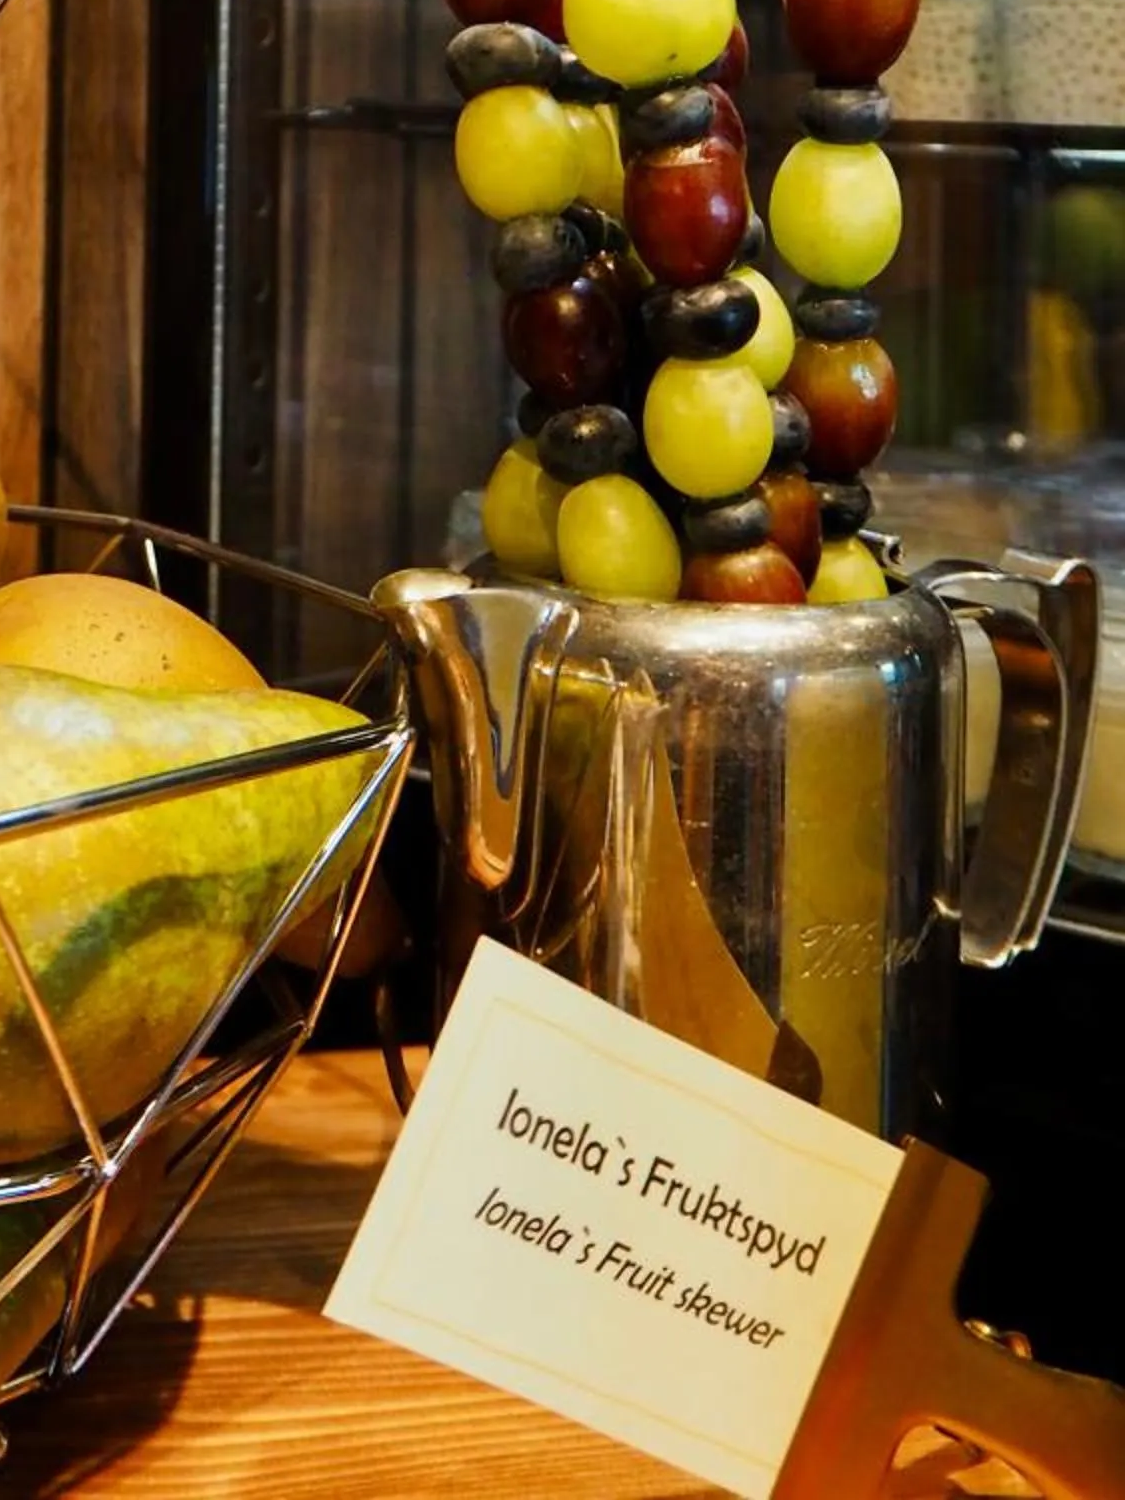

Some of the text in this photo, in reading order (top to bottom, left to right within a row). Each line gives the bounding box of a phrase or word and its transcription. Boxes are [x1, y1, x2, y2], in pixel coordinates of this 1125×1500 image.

[639, 1154, 828, 1277] Fruktspyd
[594, 1240, 676, 1302] Fruit
[672, 1281, 786, 1350] skewer
